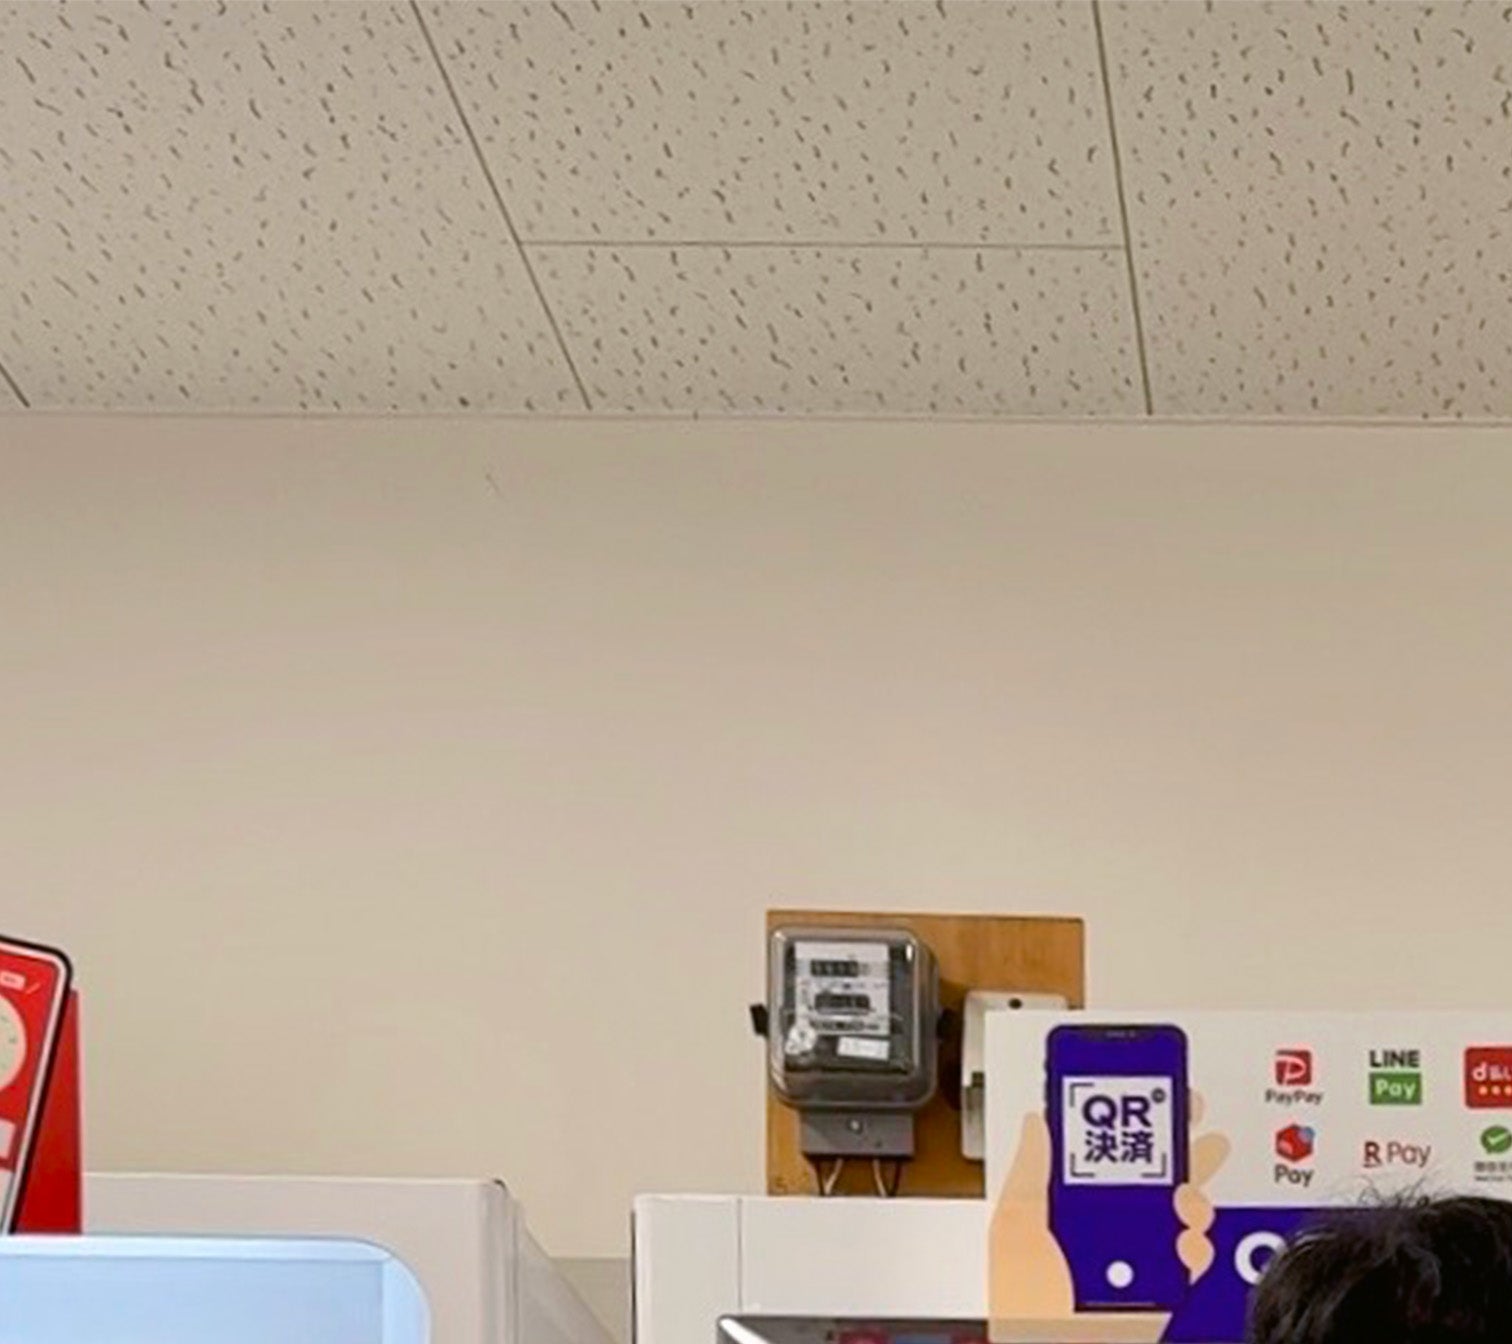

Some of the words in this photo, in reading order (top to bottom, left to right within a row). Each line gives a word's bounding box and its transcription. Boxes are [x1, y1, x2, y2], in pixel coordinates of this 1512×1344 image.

[1370, 1050, 1420, 1068] LINE
[1265, 1089, 1324, 1106] PayPay
[1375, 1078, 1416, 1099] Pay
[1082, 1095, 1152, 1129] QR
[1083, 1132, 1154, 1165] 決済
[1387, 1141, 1431, 1168] Pay
[1274, 1164, 1315, 1188] Pay
